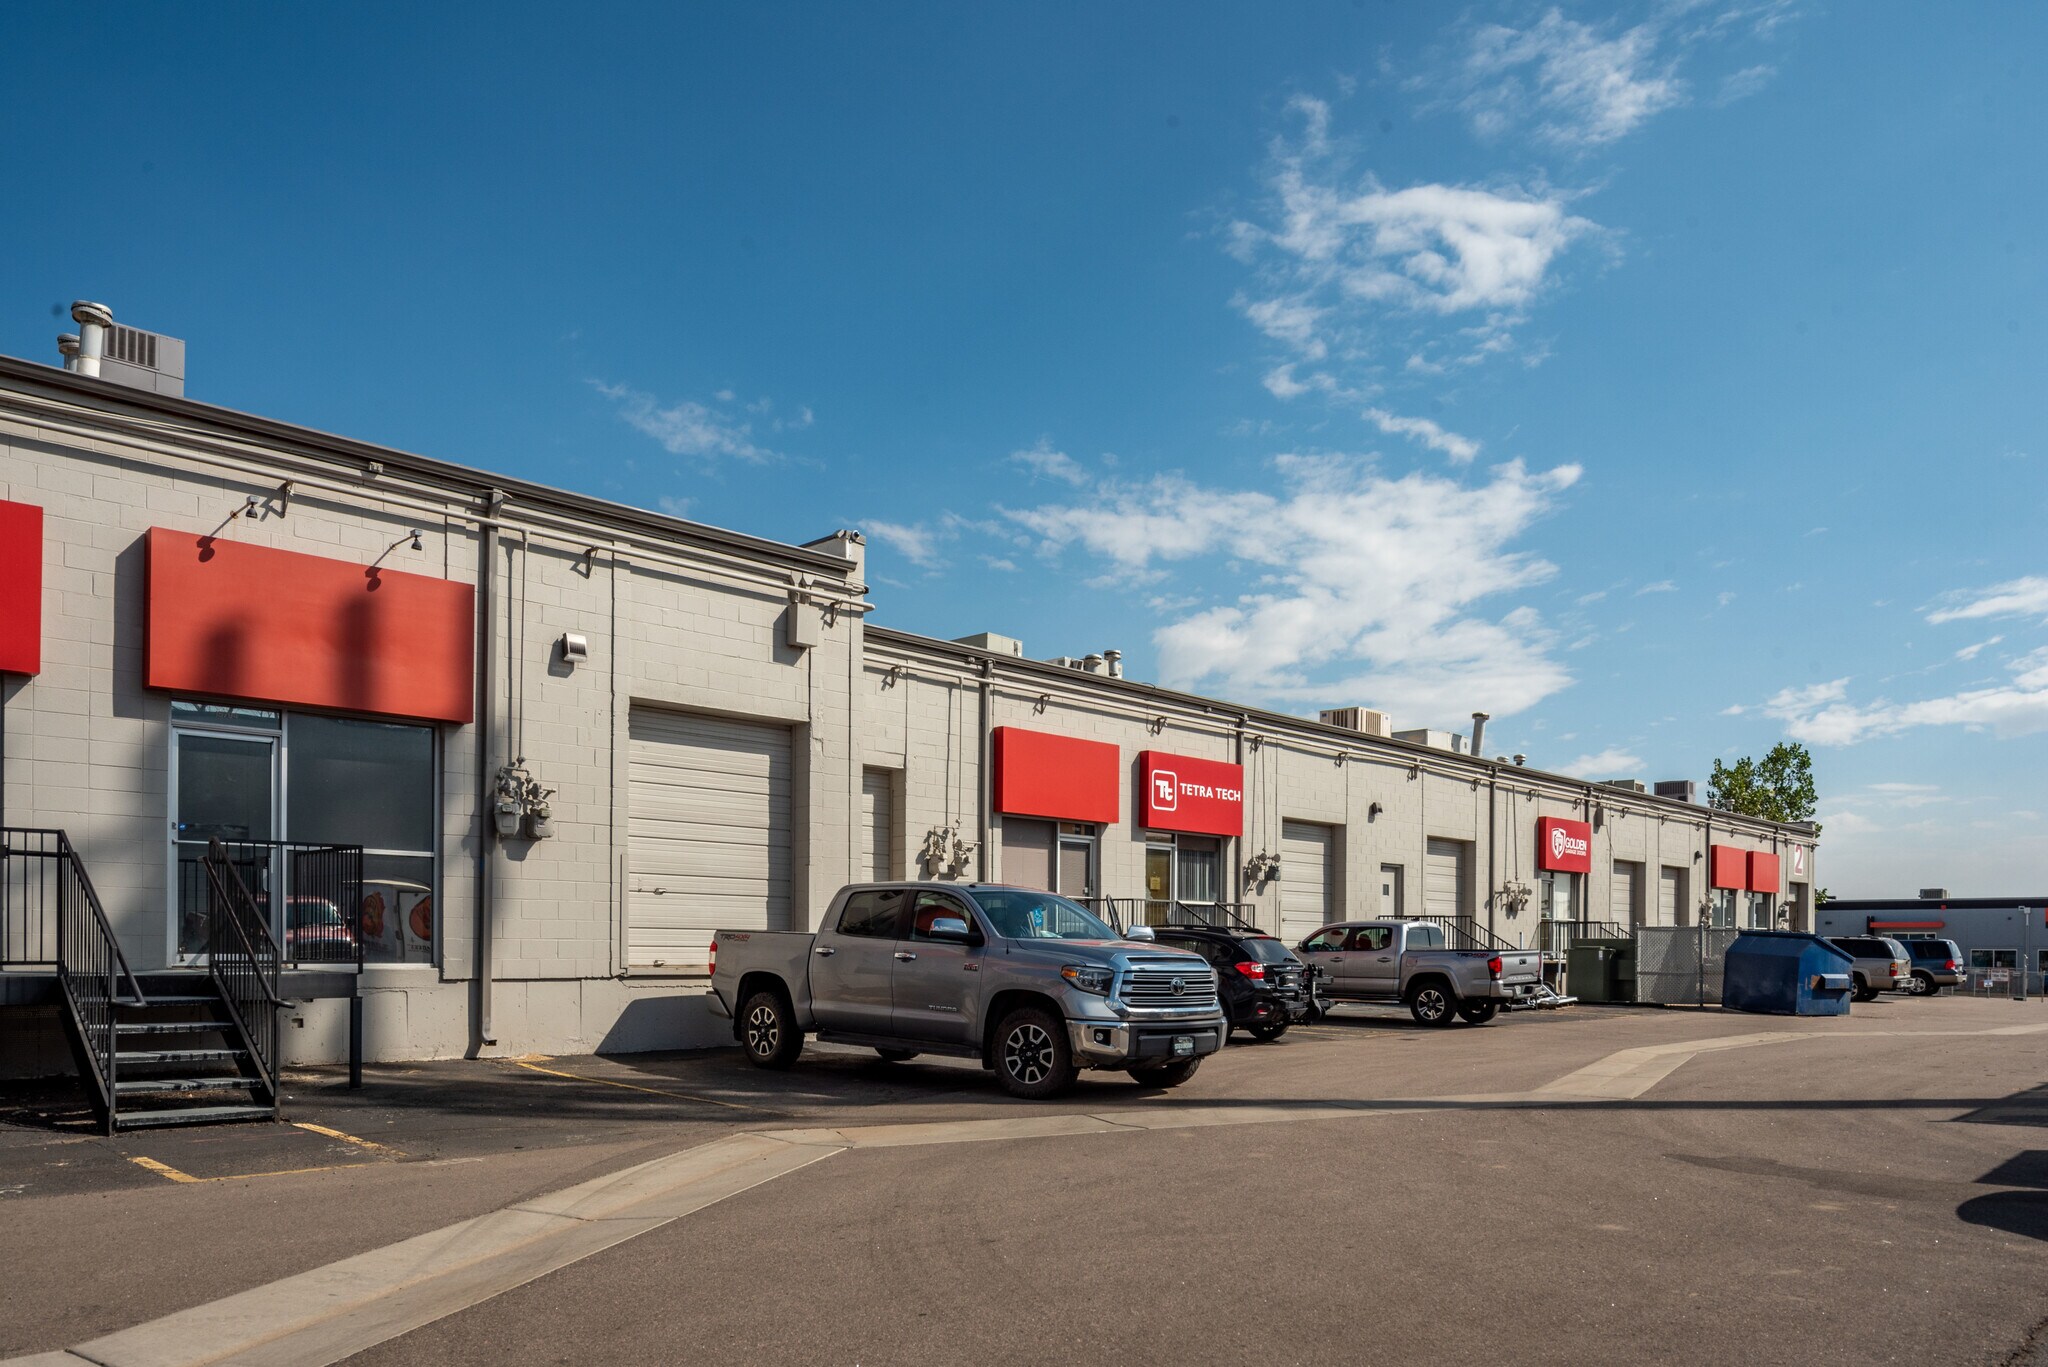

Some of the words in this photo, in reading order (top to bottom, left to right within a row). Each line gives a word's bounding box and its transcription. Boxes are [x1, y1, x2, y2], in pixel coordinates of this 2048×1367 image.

[1180, 783, 1214, 798] TETRA
[1215, 787, 1241, 802] TECH
[1565, 836, 1587, 851] GOLDEN
[1794, 844, 1803, 874] 2
